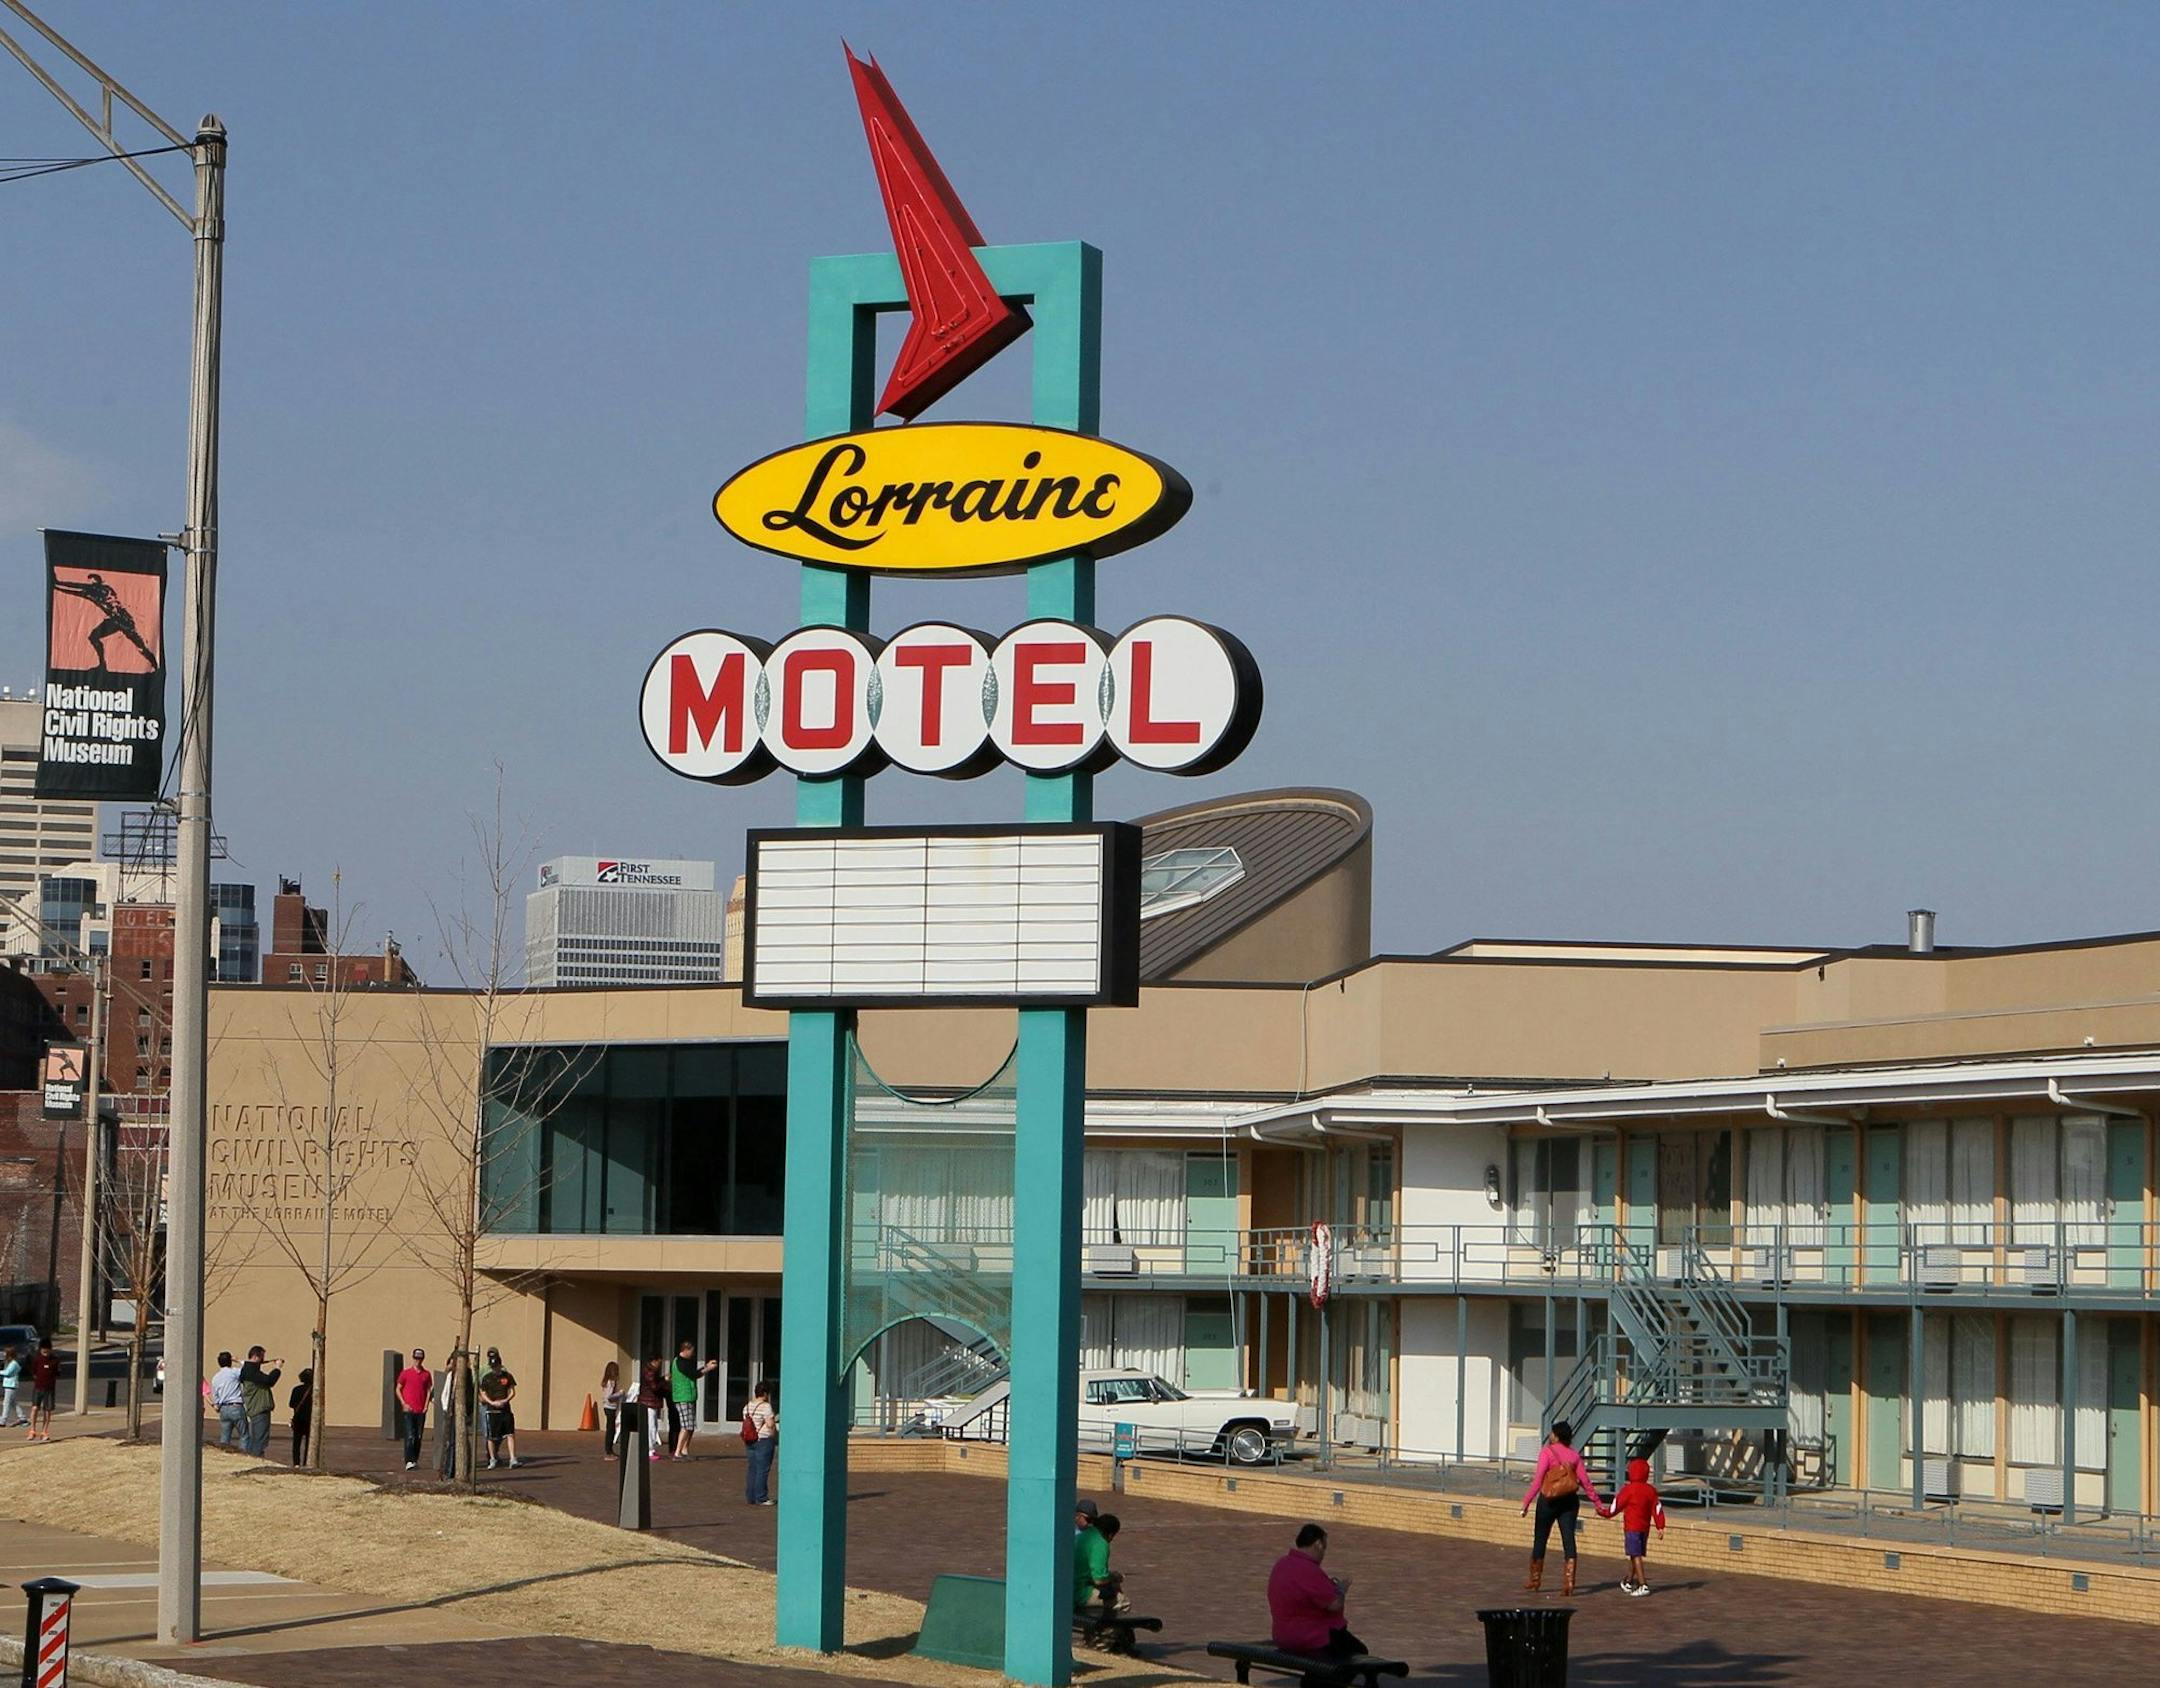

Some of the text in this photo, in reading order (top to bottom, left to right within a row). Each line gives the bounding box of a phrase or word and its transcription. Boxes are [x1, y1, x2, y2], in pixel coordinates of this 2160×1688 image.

[762, 443, 1121, 550] Lorraine
[46, 683, 134, 713] National
[668, 640, 1202, 754] MOTEL
[44, 709, 159, 743] Civil Rights
[43, 736, 134, 765] Museum
[617, 872, 682, 886] TENNESSEE
[212, 1104, 371, 1133] NATIONAL
[211, 1138, 418, 1168] CIVIL RGHTS
[209, 1173, 351, 1200] MUSEUM
[208, 1206, 227, 1219] AT
[231, 1207, 260, 1219] THE
[343, 1207, 394, 1221] MOTEL
